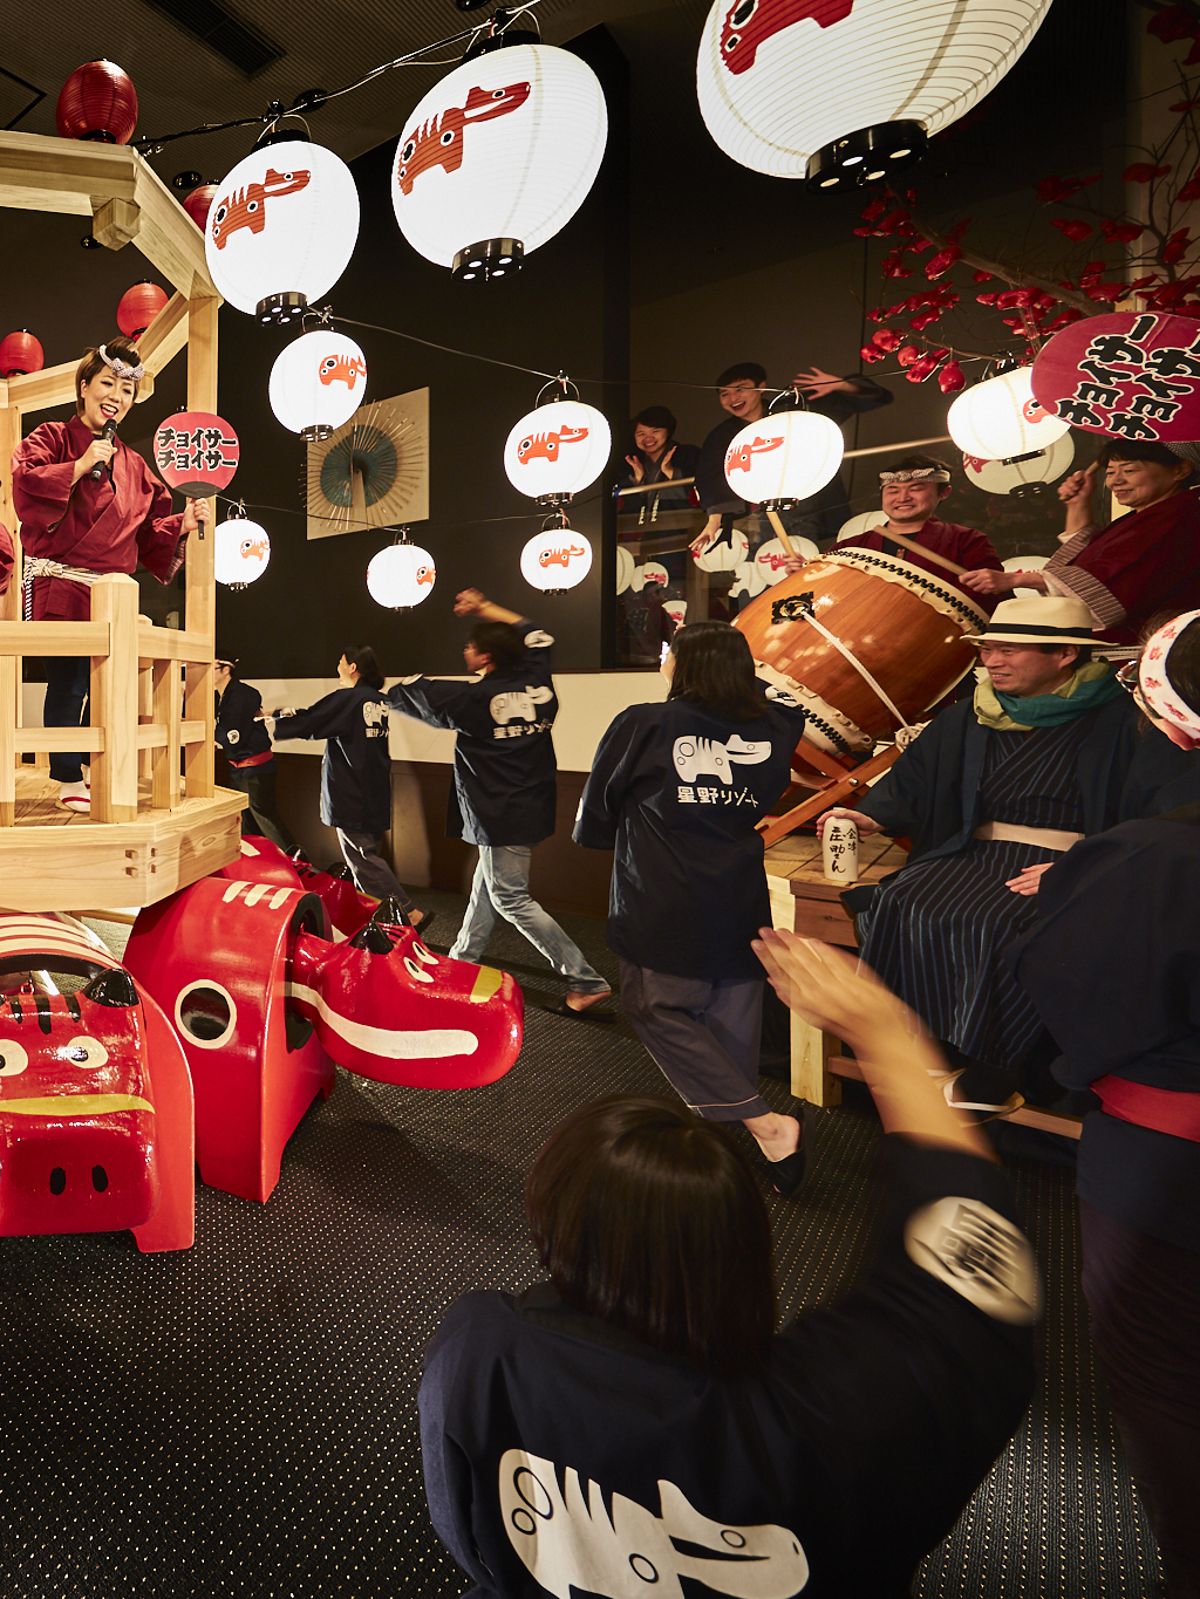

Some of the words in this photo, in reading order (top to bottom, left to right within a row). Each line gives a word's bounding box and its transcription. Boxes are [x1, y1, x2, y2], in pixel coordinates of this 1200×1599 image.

[677, 786, 760, 808] 星野リゾート
